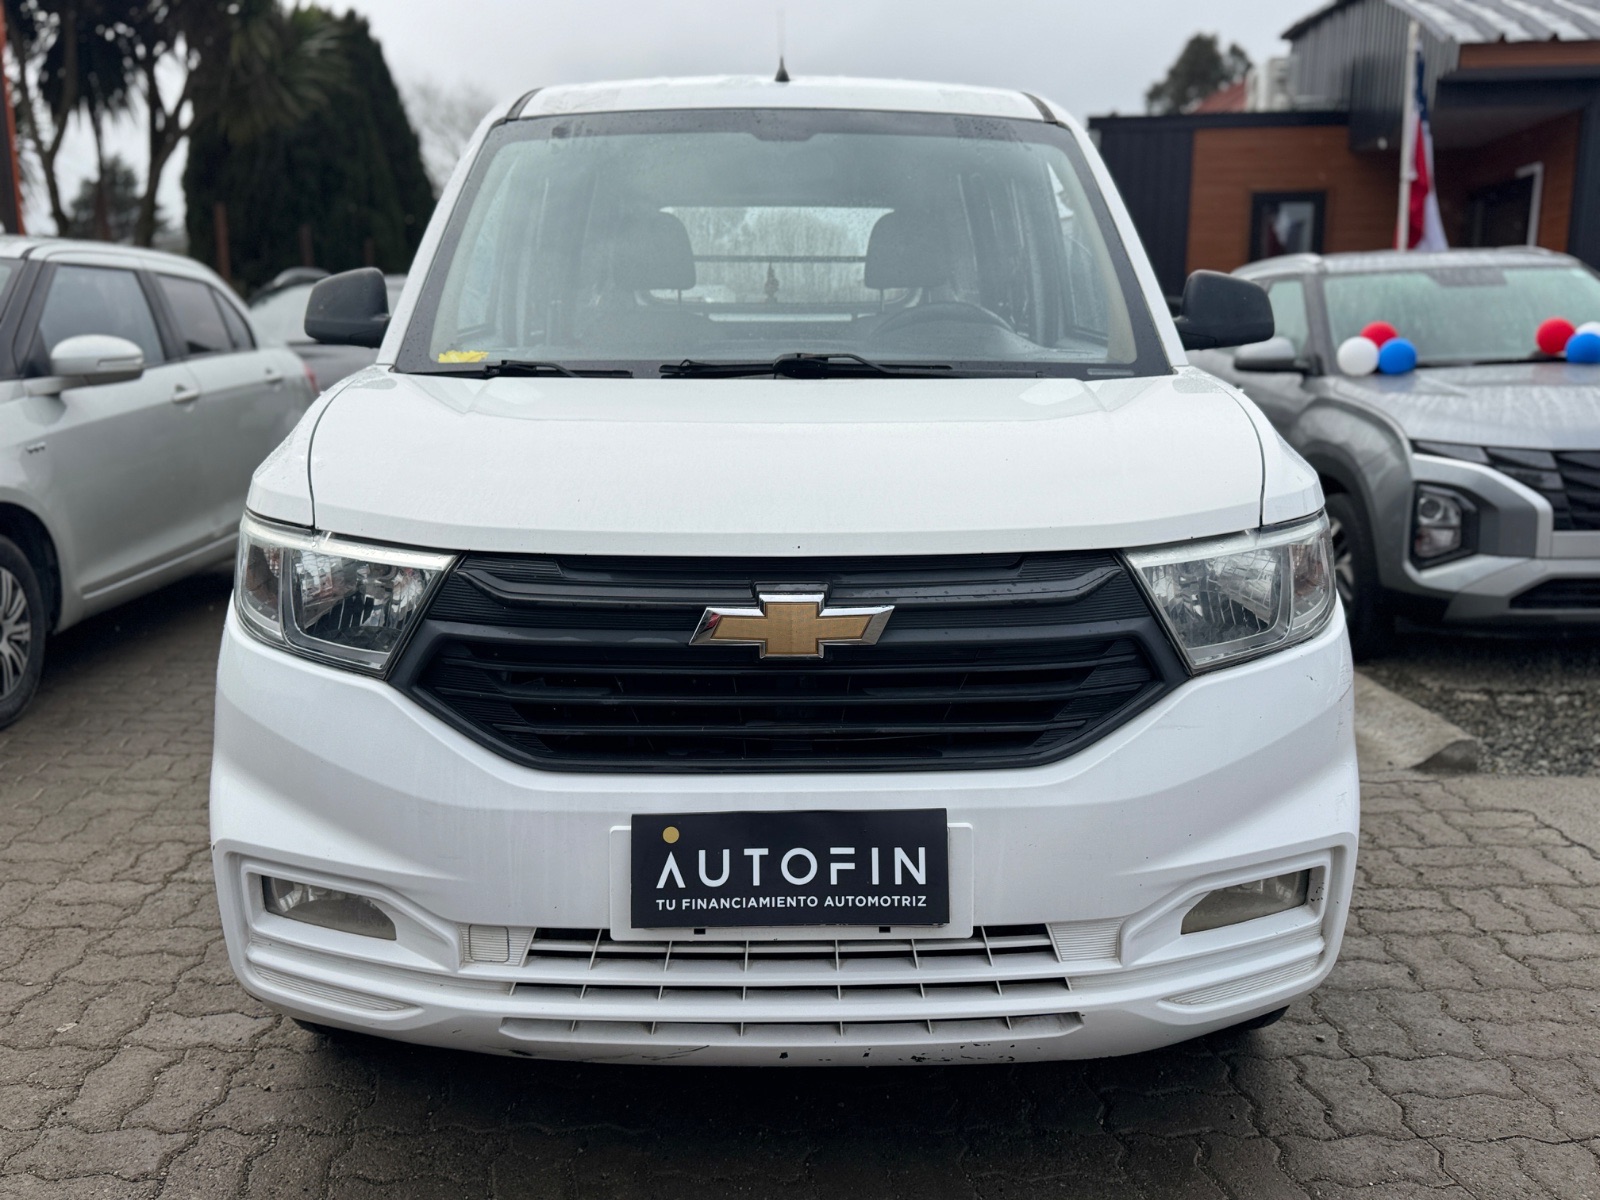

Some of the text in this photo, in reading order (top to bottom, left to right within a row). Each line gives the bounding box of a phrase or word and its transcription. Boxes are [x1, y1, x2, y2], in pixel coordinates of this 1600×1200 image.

[656, 846, 927, 889] AUTOFIN
[656, 895, 927, 911] TU FINANCIAMIENTO AUTOMOTRIZ
